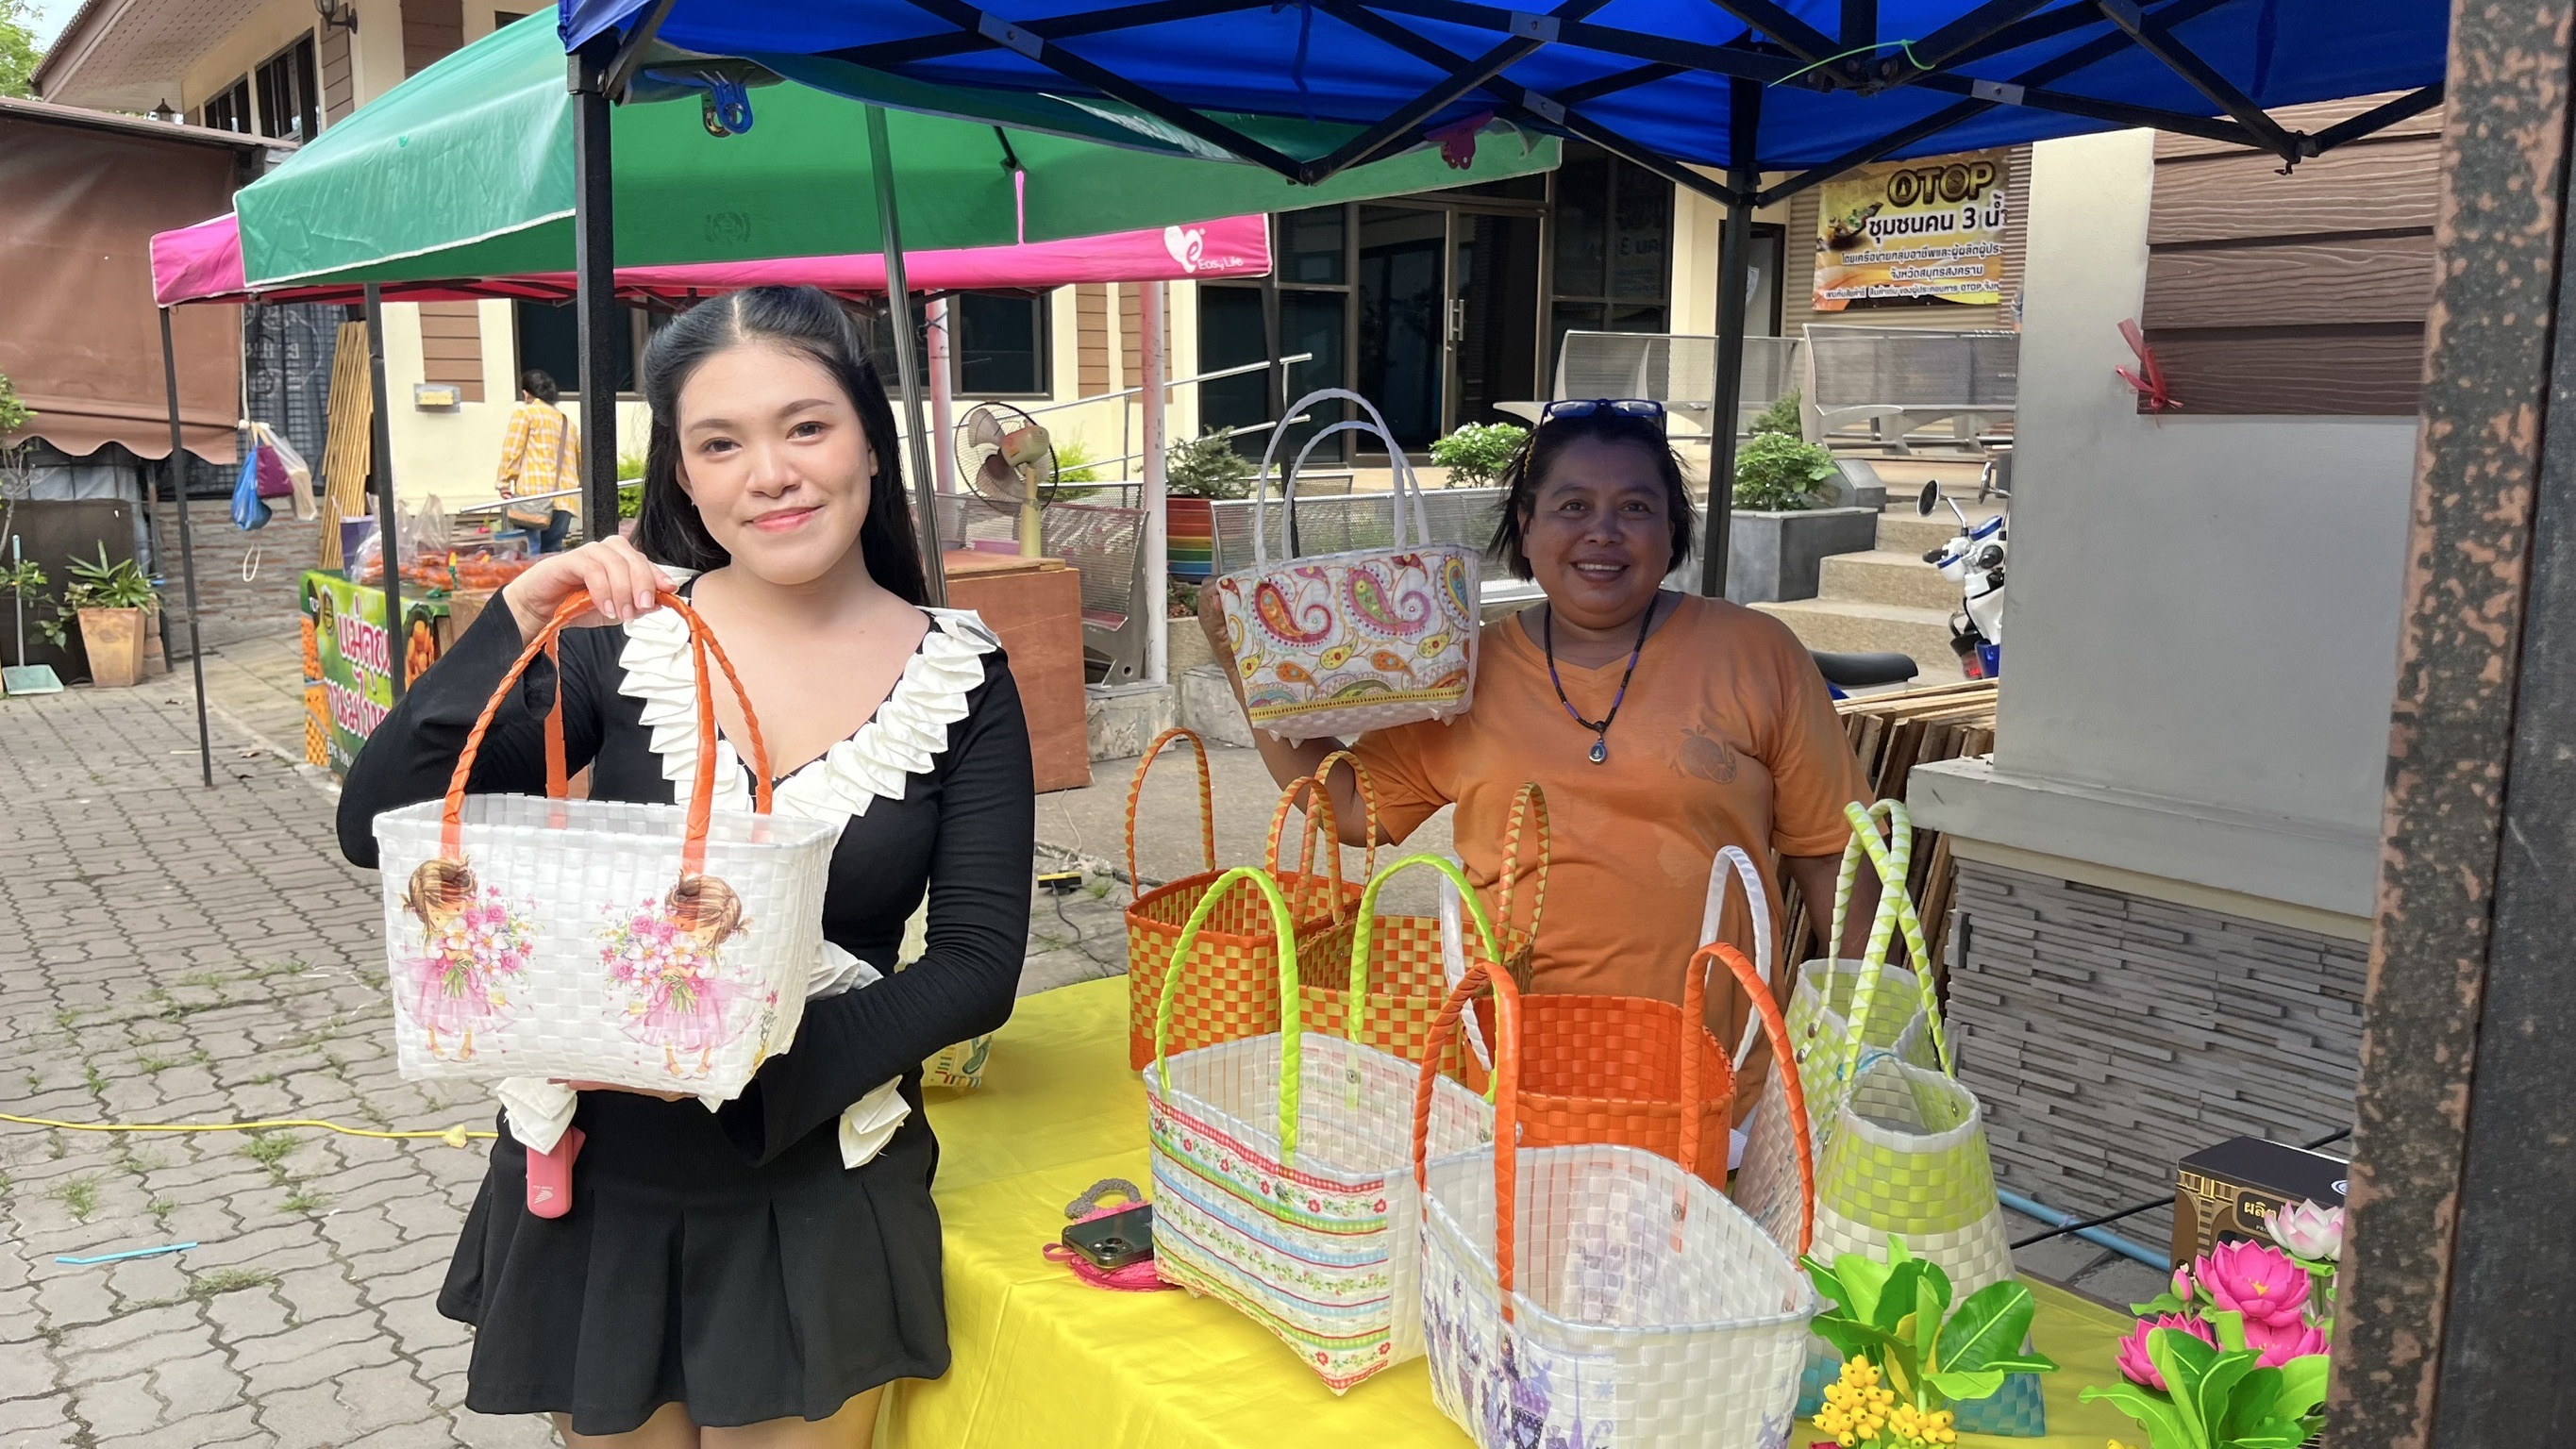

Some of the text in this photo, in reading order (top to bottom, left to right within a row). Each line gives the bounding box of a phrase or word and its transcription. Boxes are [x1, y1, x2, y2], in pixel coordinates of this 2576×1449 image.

[1888, 161, 1996, 208] OTOP
[1868, 213, 1954, 243] ชุมชนคน
[1963, 207, 1976, 229] 3
